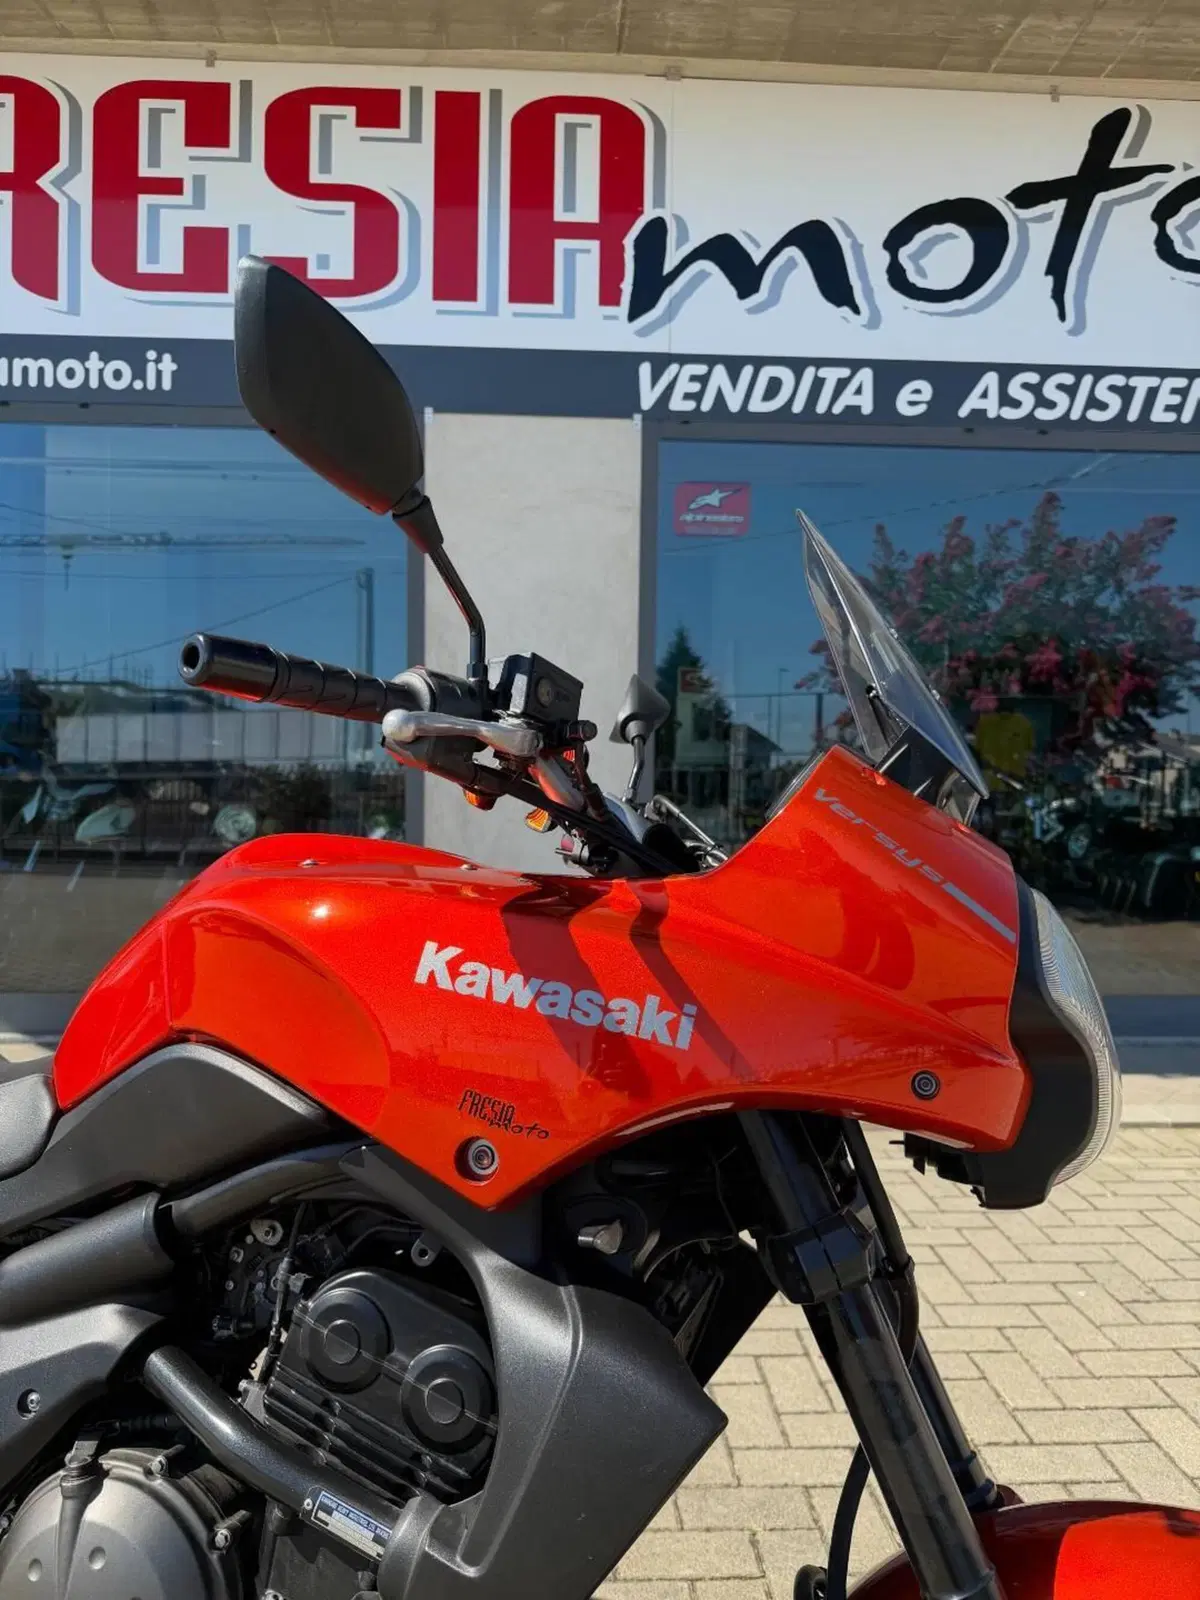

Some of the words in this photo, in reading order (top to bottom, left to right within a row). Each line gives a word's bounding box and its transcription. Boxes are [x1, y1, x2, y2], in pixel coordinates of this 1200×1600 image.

[638, 361, 874, 415] VENDITA
[895, 379, 933, 416] e
[414, 940, 698, 1051] Kawasaki
[458, 1090, 515, 1128] FRESIA
